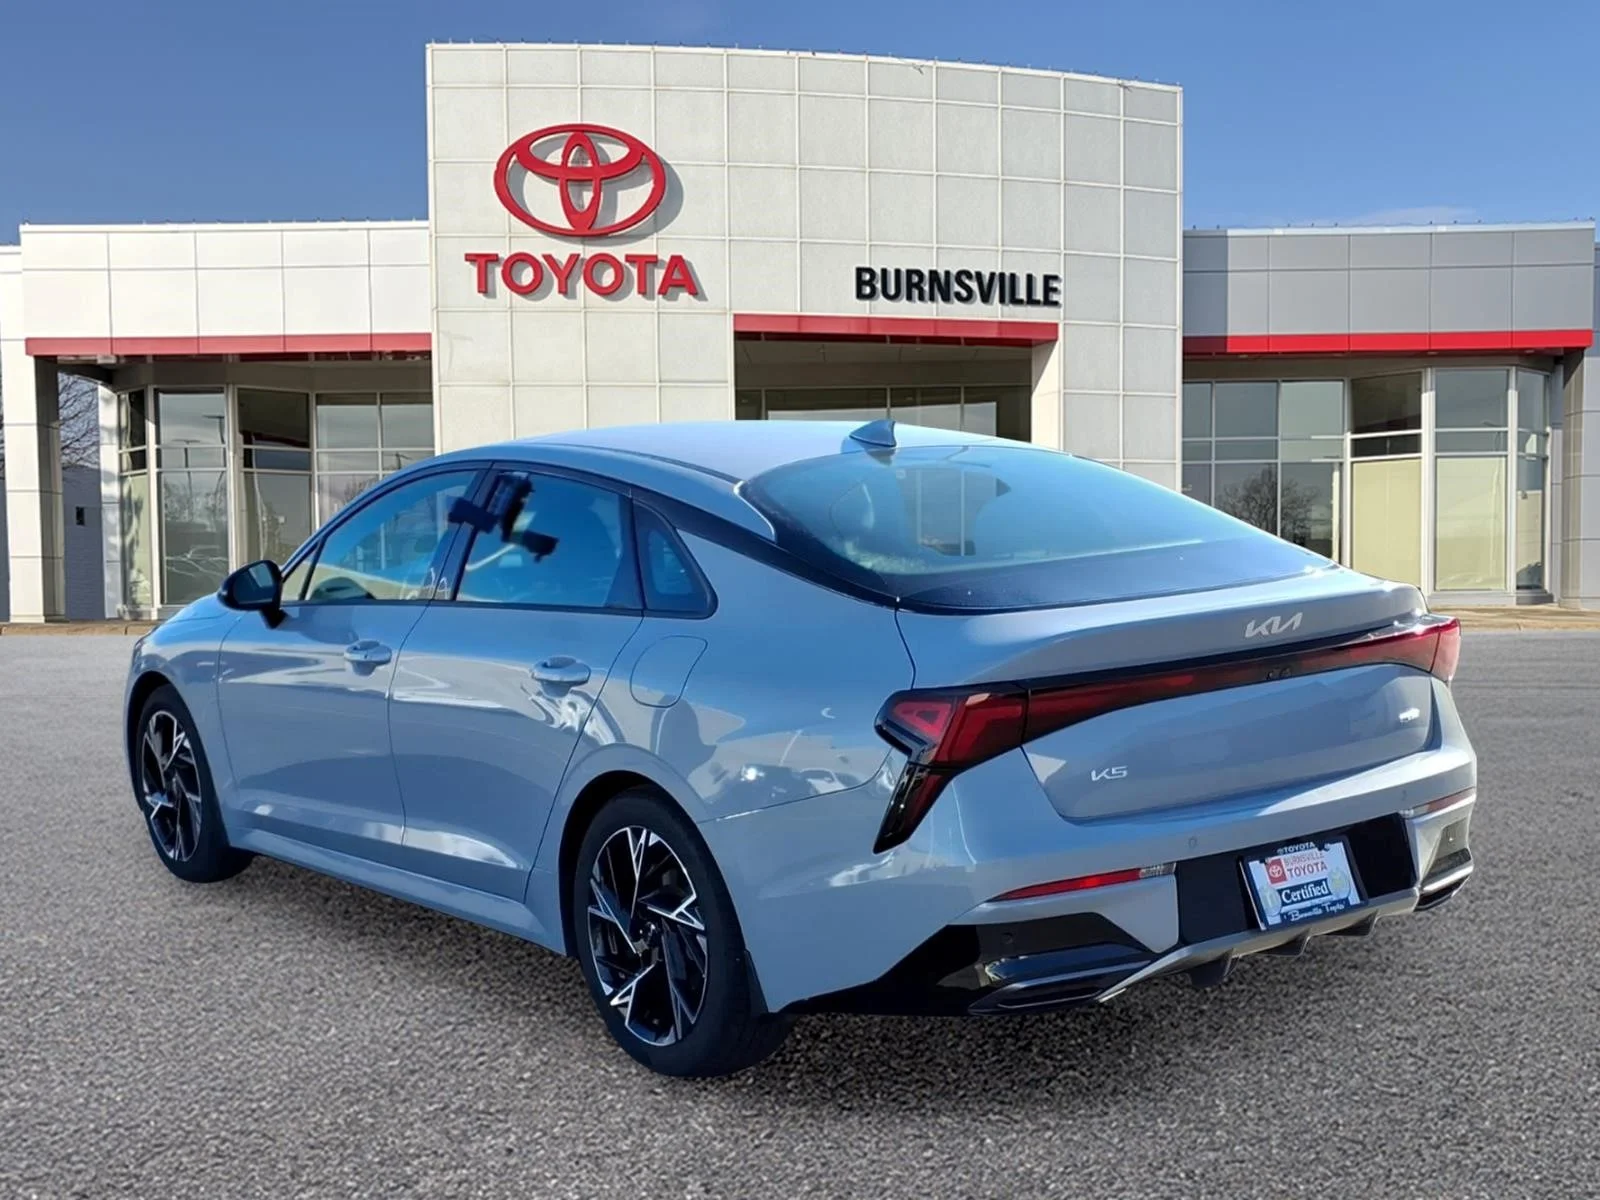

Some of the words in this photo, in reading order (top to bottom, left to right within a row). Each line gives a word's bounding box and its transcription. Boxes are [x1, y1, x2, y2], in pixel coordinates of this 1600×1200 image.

[465, 252, 699, 297] TOYOTA
[855, 265, 1062, 307] BURNSVILLE
[1090, 765, 1128, 783] K5
[1283, 841, 1316, 855] TOYOTA
[1287, 860, 1328, 878] TOYOTA
[1281, 882, 1330, 904] Certified
